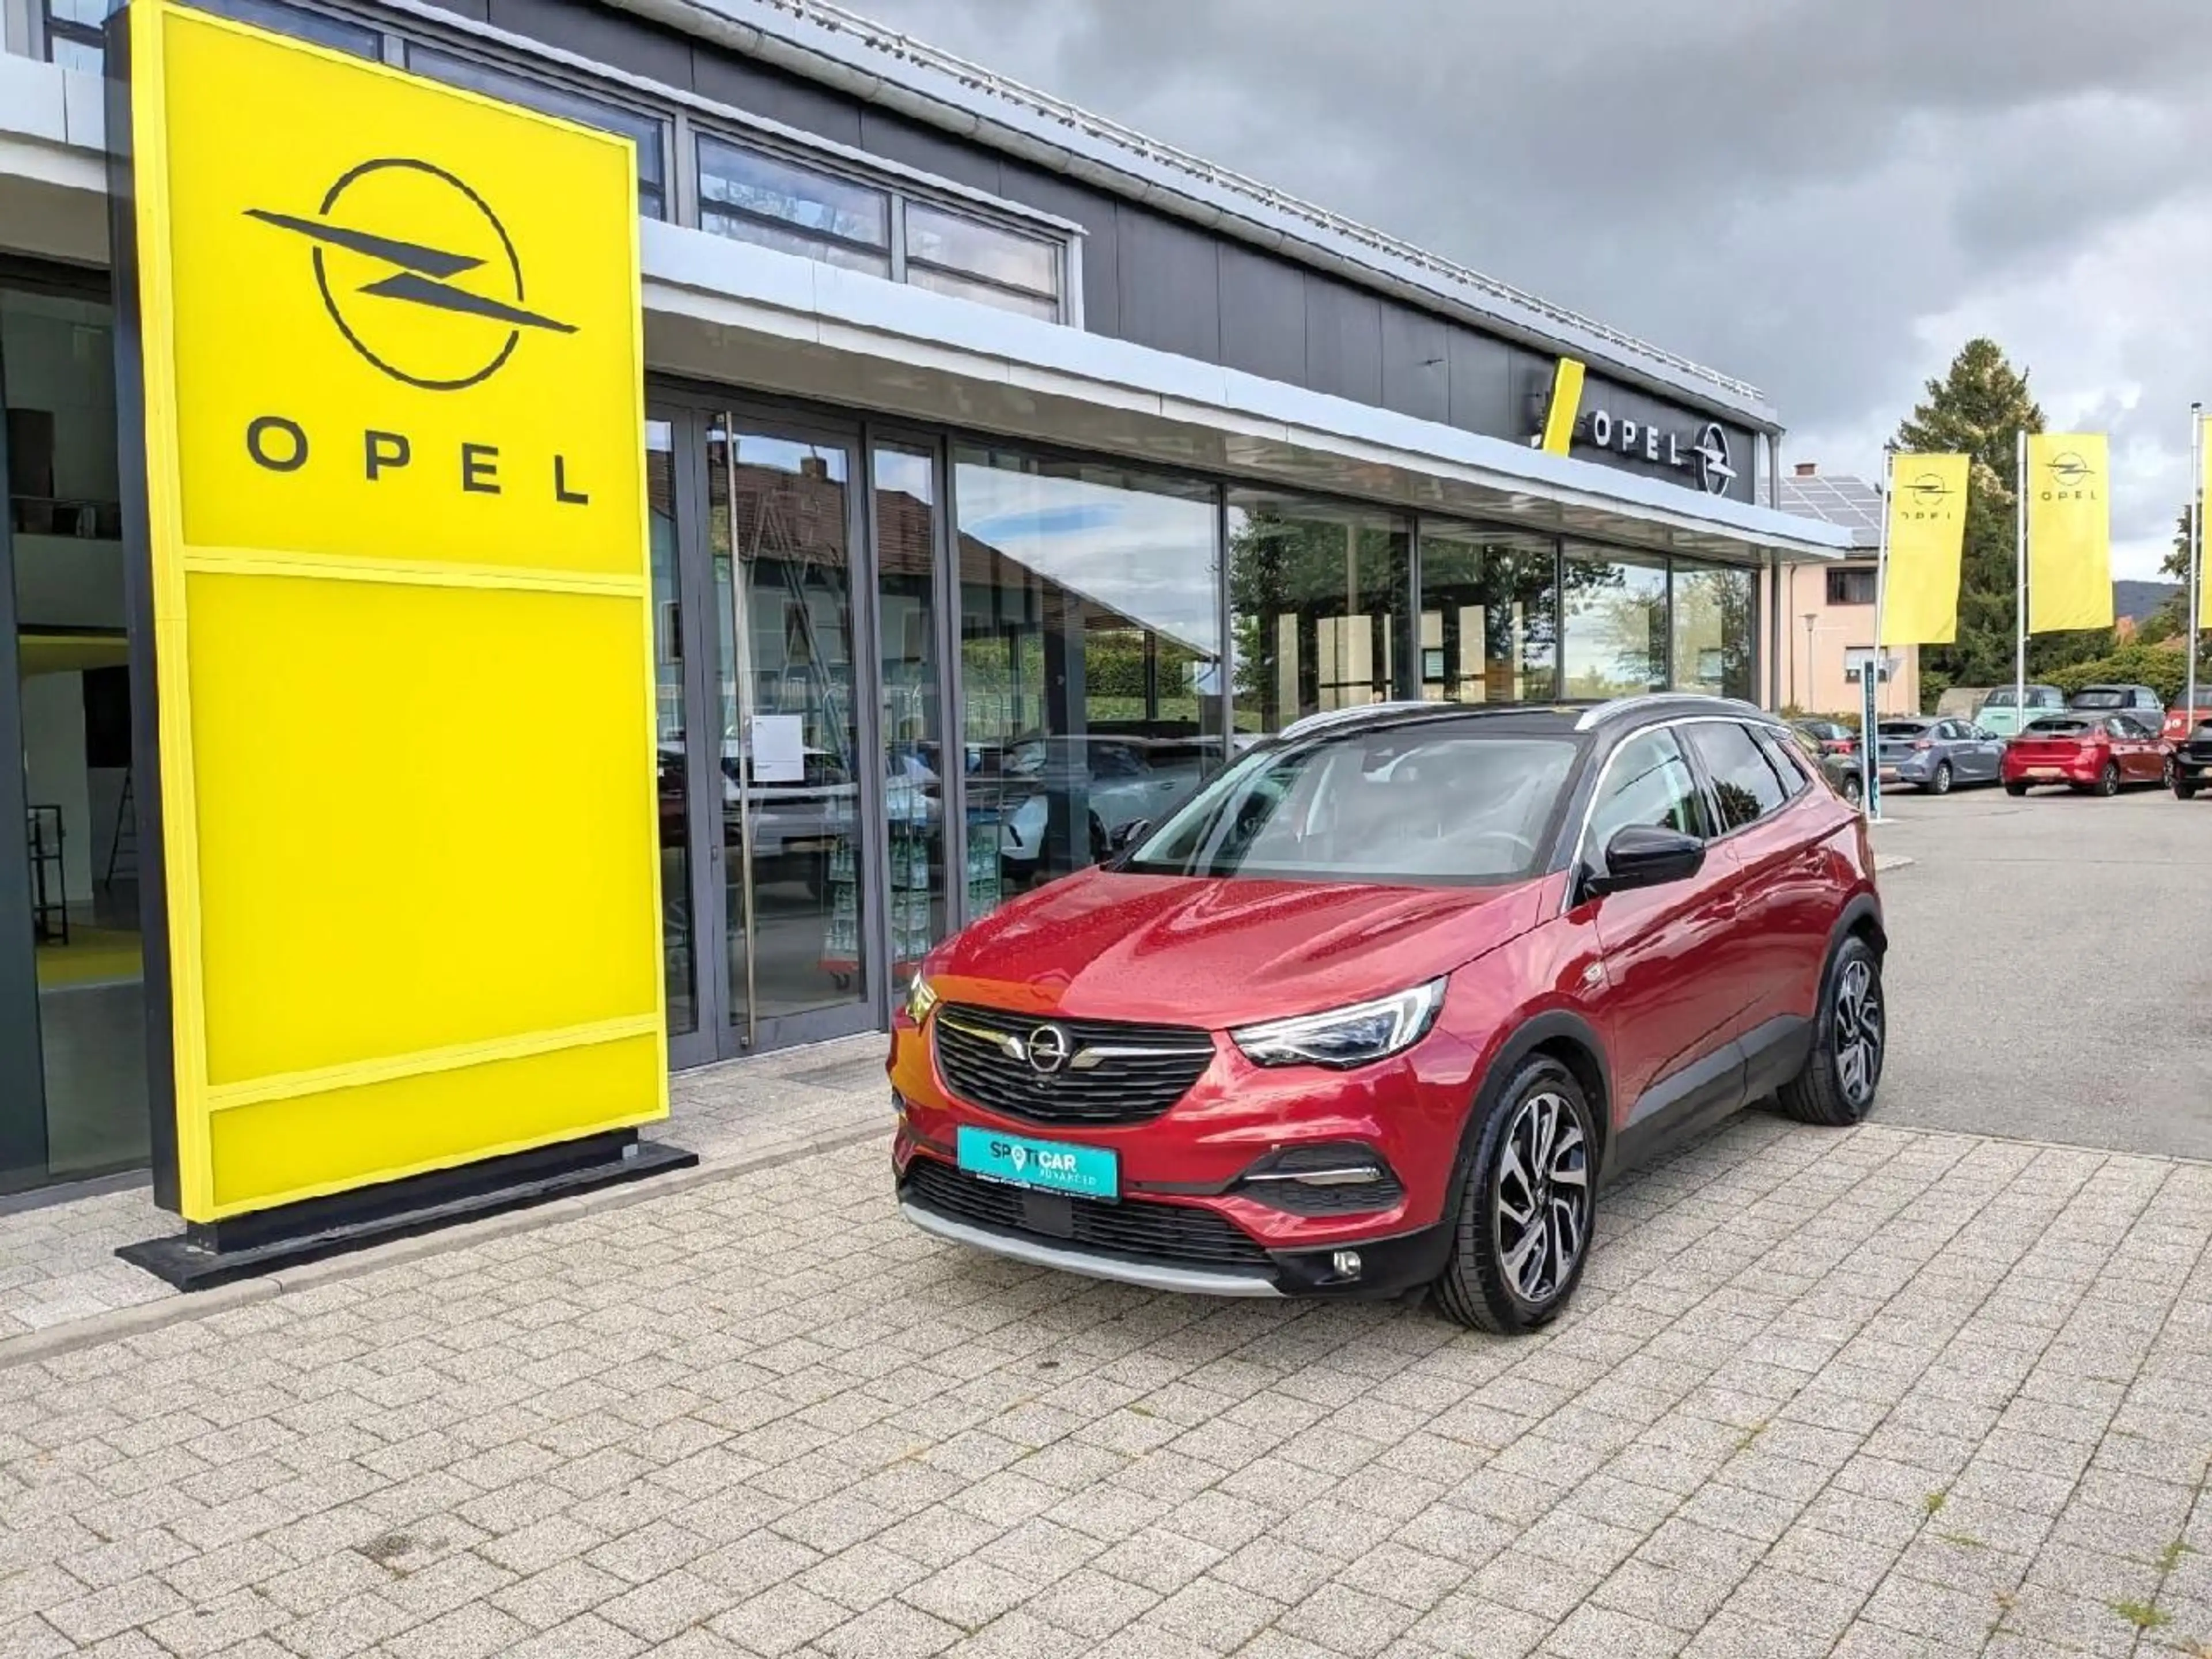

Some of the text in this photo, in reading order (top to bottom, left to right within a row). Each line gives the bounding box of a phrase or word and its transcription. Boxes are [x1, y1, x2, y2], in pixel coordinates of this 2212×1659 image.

[247, 416, 588, 505] OPEL
[1594, 410, 1683, 465] OPEL
[2041, 490, 2097, 501] OPEL
